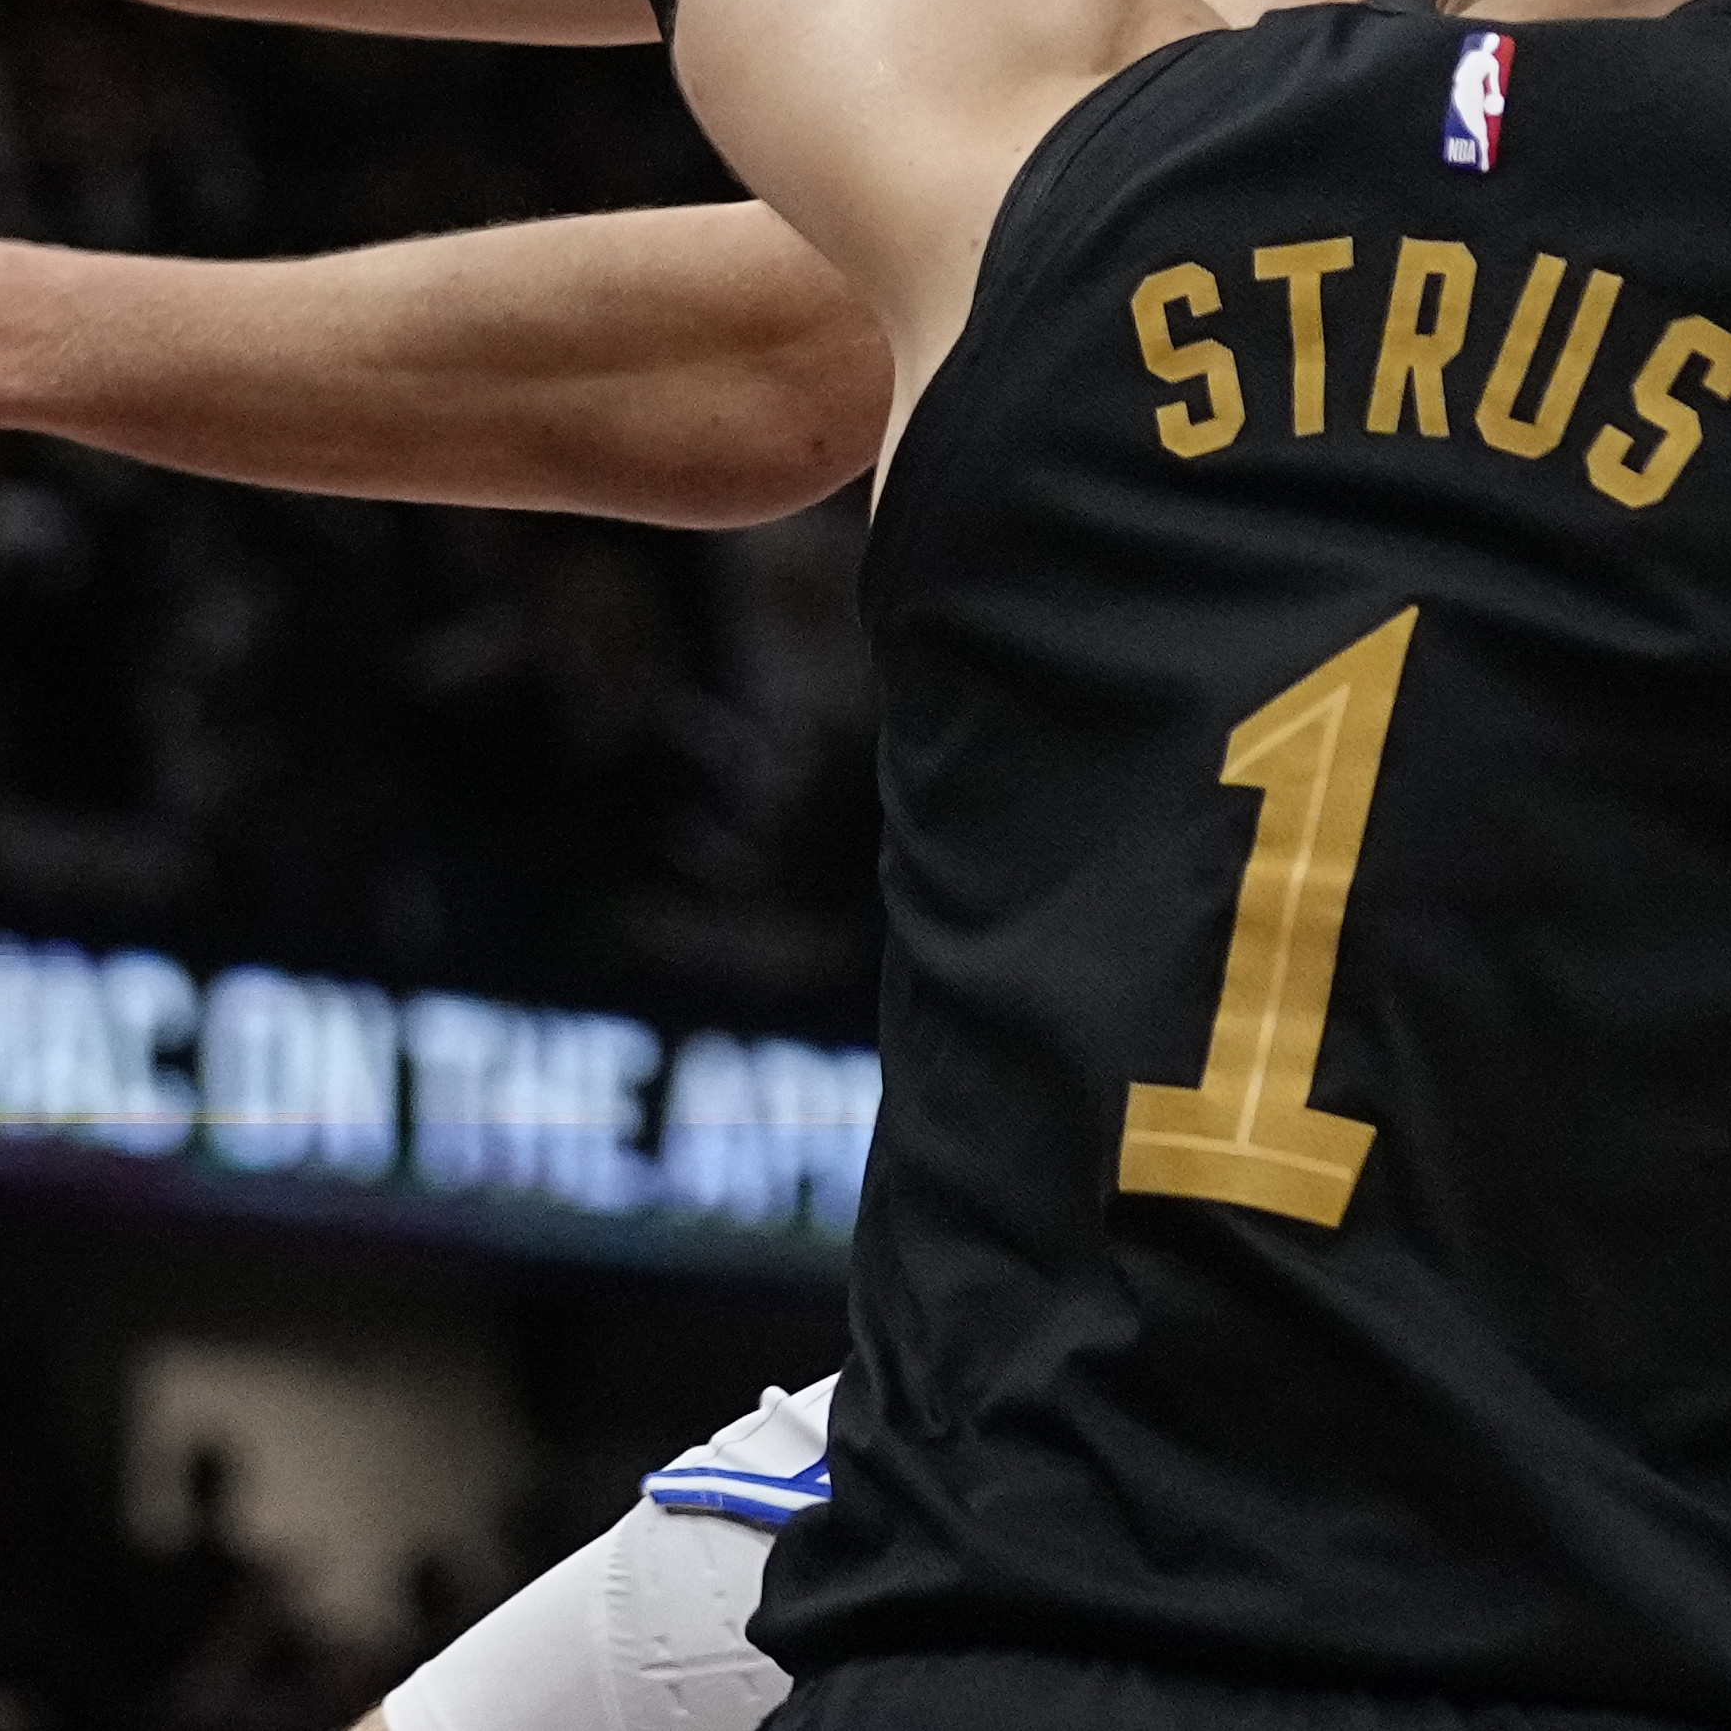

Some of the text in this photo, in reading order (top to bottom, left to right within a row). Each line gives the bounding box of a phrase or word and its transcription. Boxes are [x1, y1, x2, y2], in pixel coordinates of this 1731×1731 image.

[205, 963, 397, 1168] ON
[400, 987, 665, 1212] THE
[1117, 604, 1420, 1229] 1
